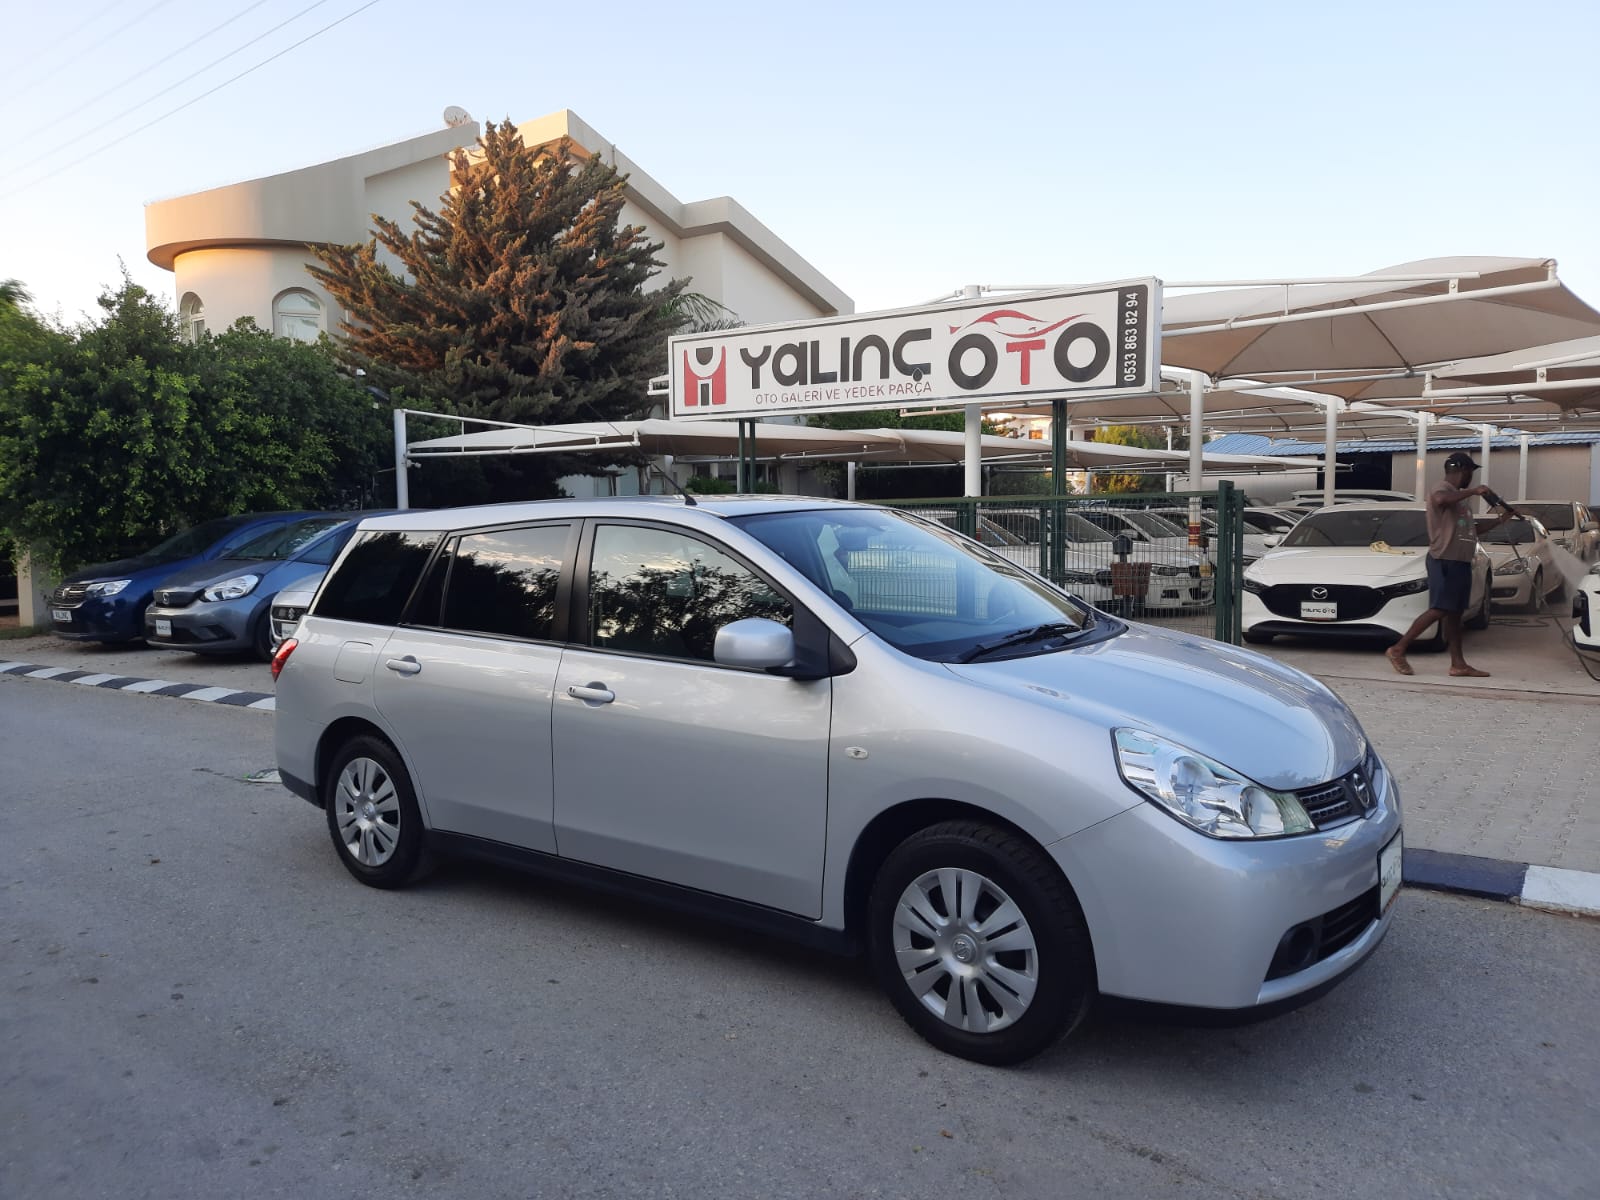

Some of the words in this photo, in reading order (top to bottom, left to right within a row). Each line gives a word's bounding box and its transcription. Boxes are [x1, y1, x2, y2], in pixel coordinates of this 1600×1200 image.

[1126, 292, 1139, 308] 94
[1125, 310, 1138, 325] 82
[1124, 328, 1138, 350] 863
[948, 322, 1111, 390] OTO
[1123, 352, 1137, 382] 0533
[755, 393, 778, 405] OTO
[781, 388, 822, 403] GALERİ
[825, 388, 841, 400] VE
[844, 385, 885, 399] YEDEK
[888, 381, 932, 396] PARÇA
